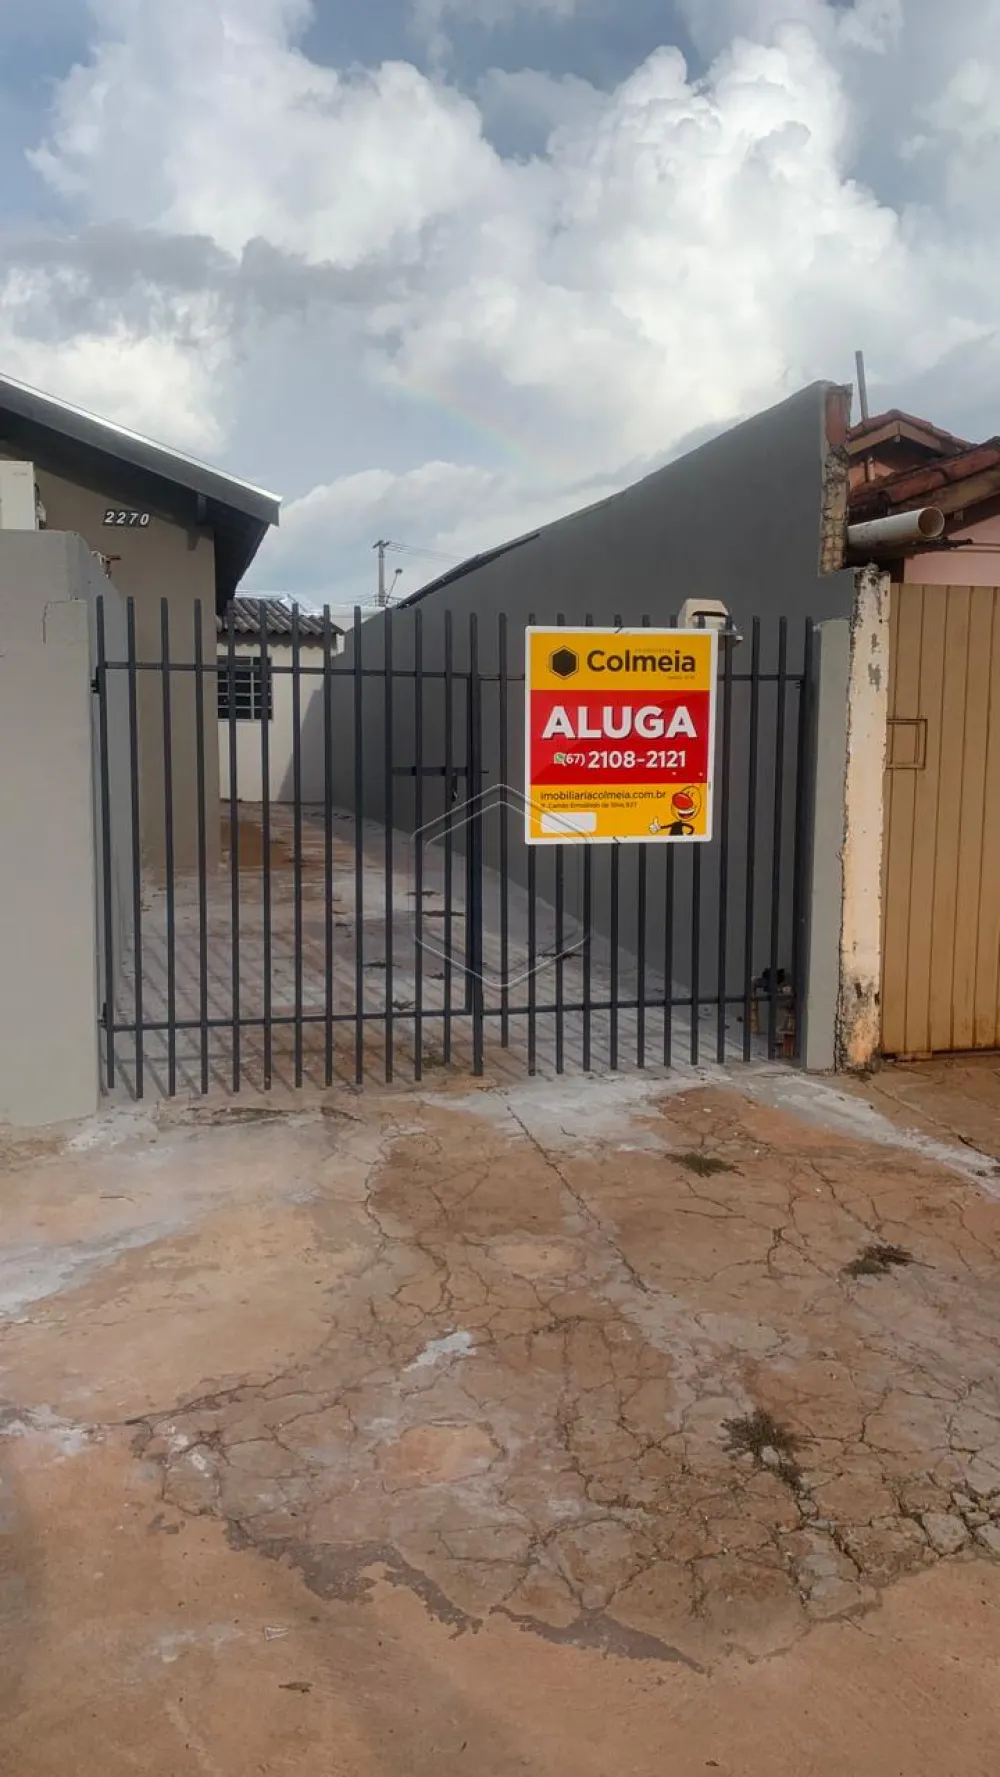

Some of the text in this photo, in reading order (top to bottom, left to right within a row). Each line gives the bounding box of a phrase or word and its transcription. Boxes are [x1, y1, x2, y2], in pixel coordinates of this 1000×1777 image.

[104, 511, 150, 526] 2270
[586, 649, 696, 672] Colmeia
[541, 705, 698, 739] ALUGA
[563, 750, 686, 769] (67) 2108-2121
[540, 790, 666, 801] imobiliariacolmeia.com.br
